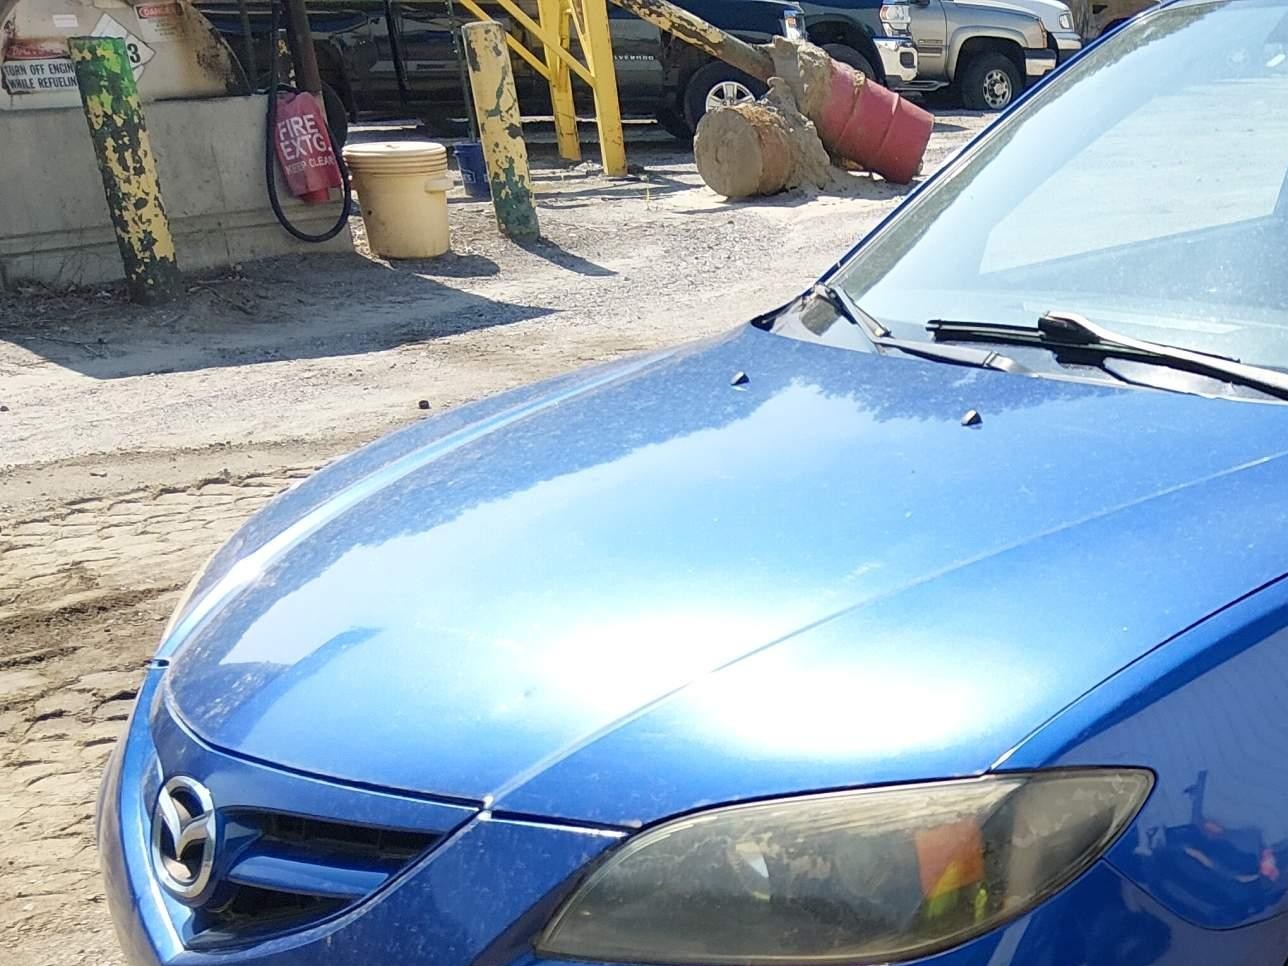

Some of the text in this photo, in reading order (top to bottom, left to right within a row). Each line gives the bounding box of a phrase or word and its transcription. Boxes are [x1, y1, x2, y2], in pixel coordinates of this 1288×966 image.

[127, 43, 141, 63] 3
[4, 62, 76, 76] TURN OFF ENGIN
[8, 77, 78, 89] WHILE REFUELIN
[277, 114, 319, 141] FIRE
